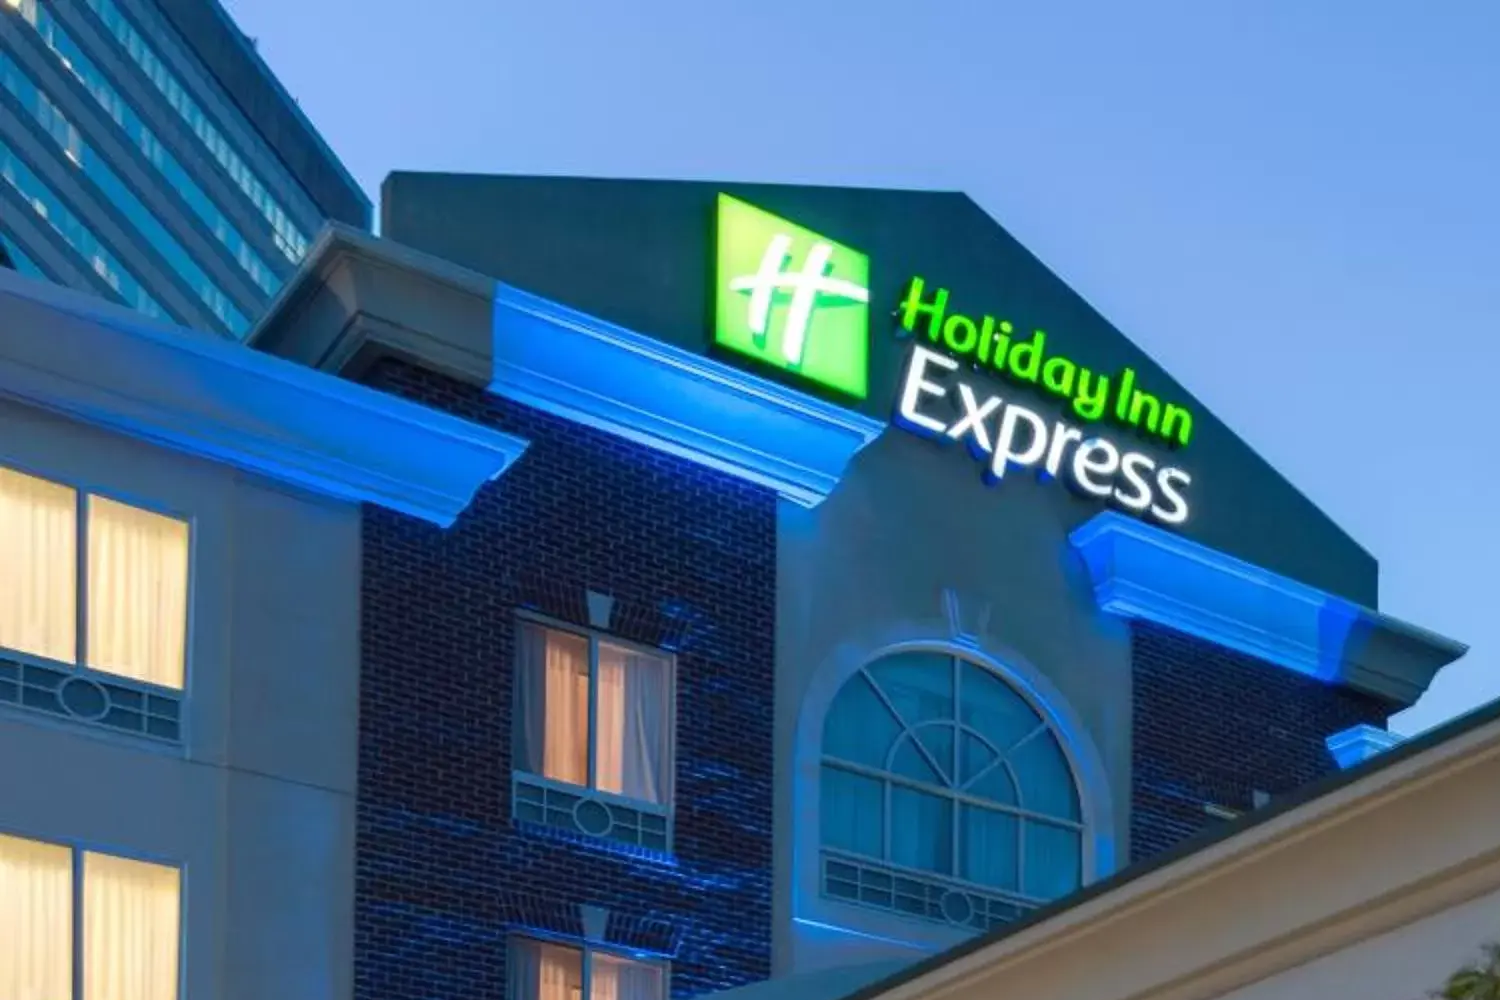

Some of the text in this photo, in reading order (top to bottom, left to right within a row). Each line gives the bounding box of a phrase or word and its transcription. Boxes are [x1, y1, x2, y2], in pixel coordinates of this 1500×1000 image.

[899, 345, 1192, 524] Express
[900, 276, 1193, 447] Holiday Inn
